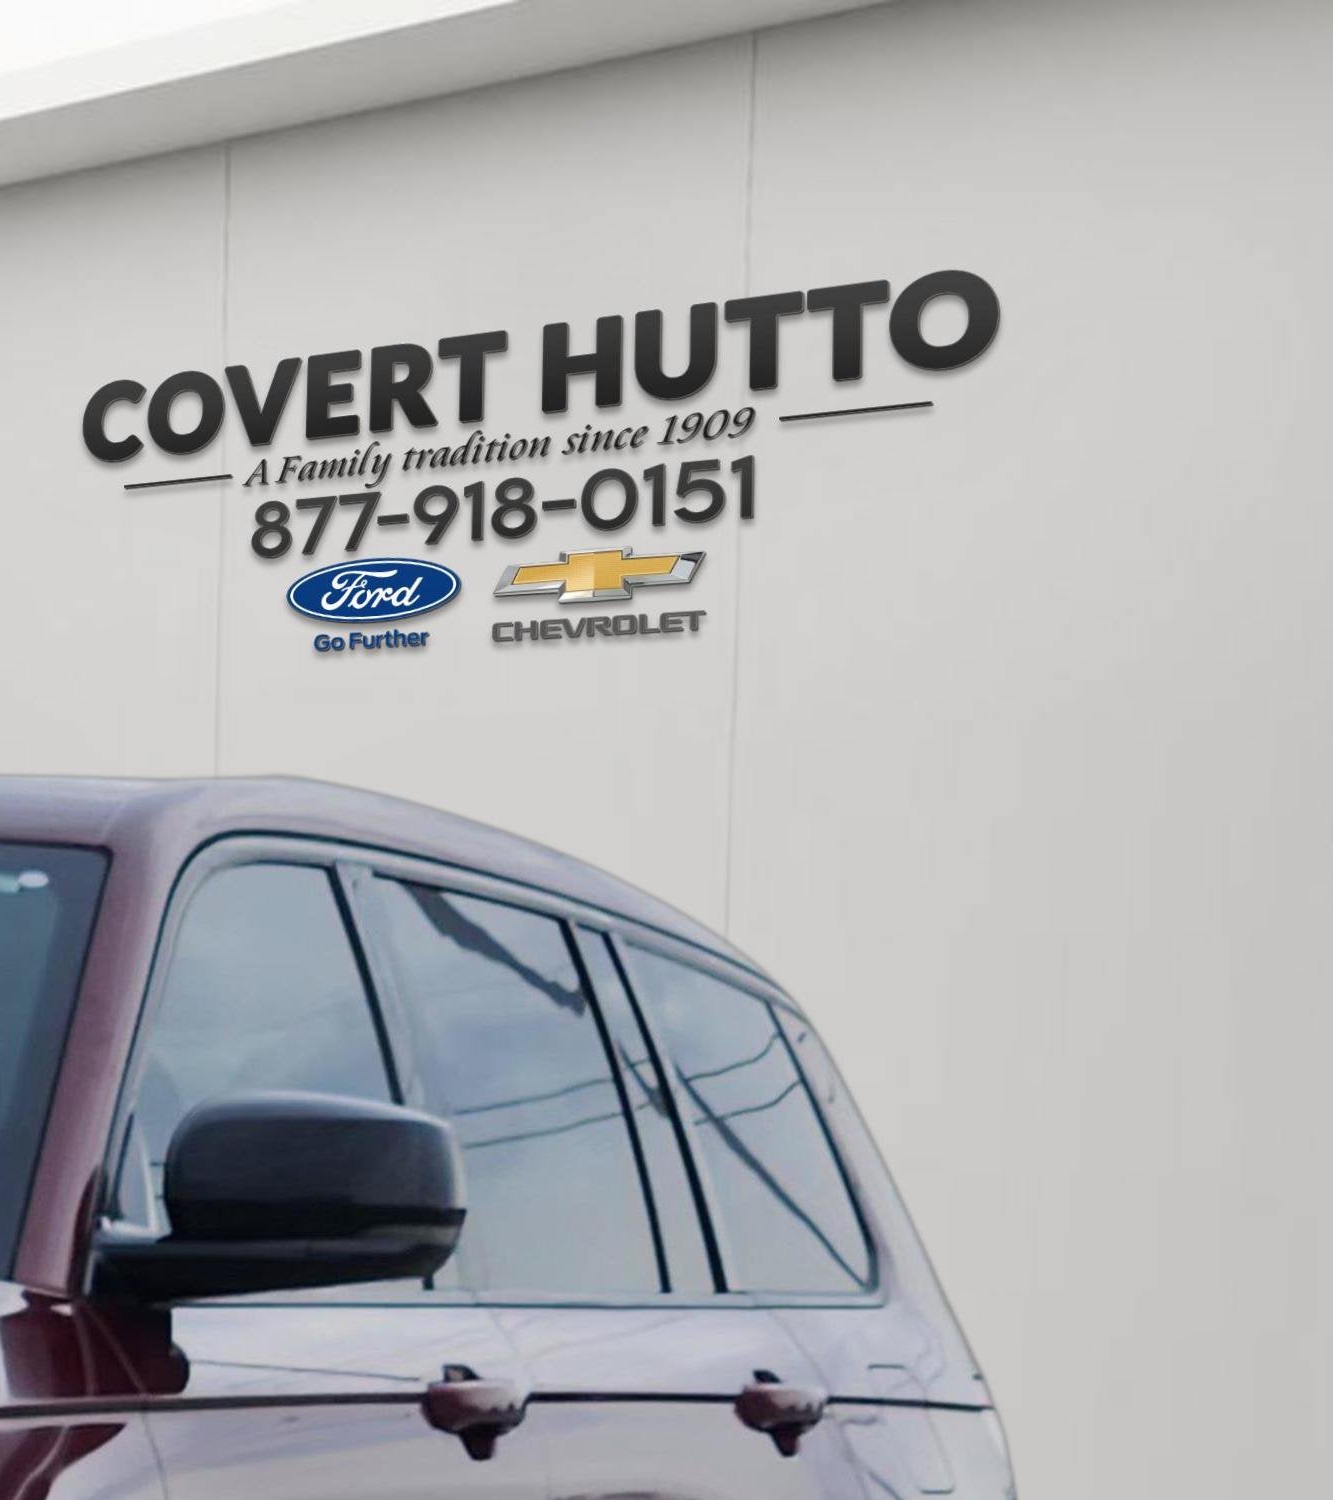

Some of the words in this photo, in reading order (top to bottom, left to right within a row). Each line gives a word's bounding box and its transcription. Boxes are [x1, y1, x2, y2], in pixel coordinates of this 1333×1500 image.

[81, 329, 508, 463] COVERT
[540, 269, 1001, 413] HUTTO
[241, 458, 269, 487] A
[275, 441, 392, 489] Family
[401, 430, 552, 472] tradition
[561, 424, 649, 456] since
[657, 406, 756, 446] 1909
[251, 454, 755, 559] 877-918-0151
[321, 569, 423, 611] Ford
[312, 633, 345, 654] Go
[348, 628, 430, 650] Further
[491, 609, 708, 643] CHEVROLET
